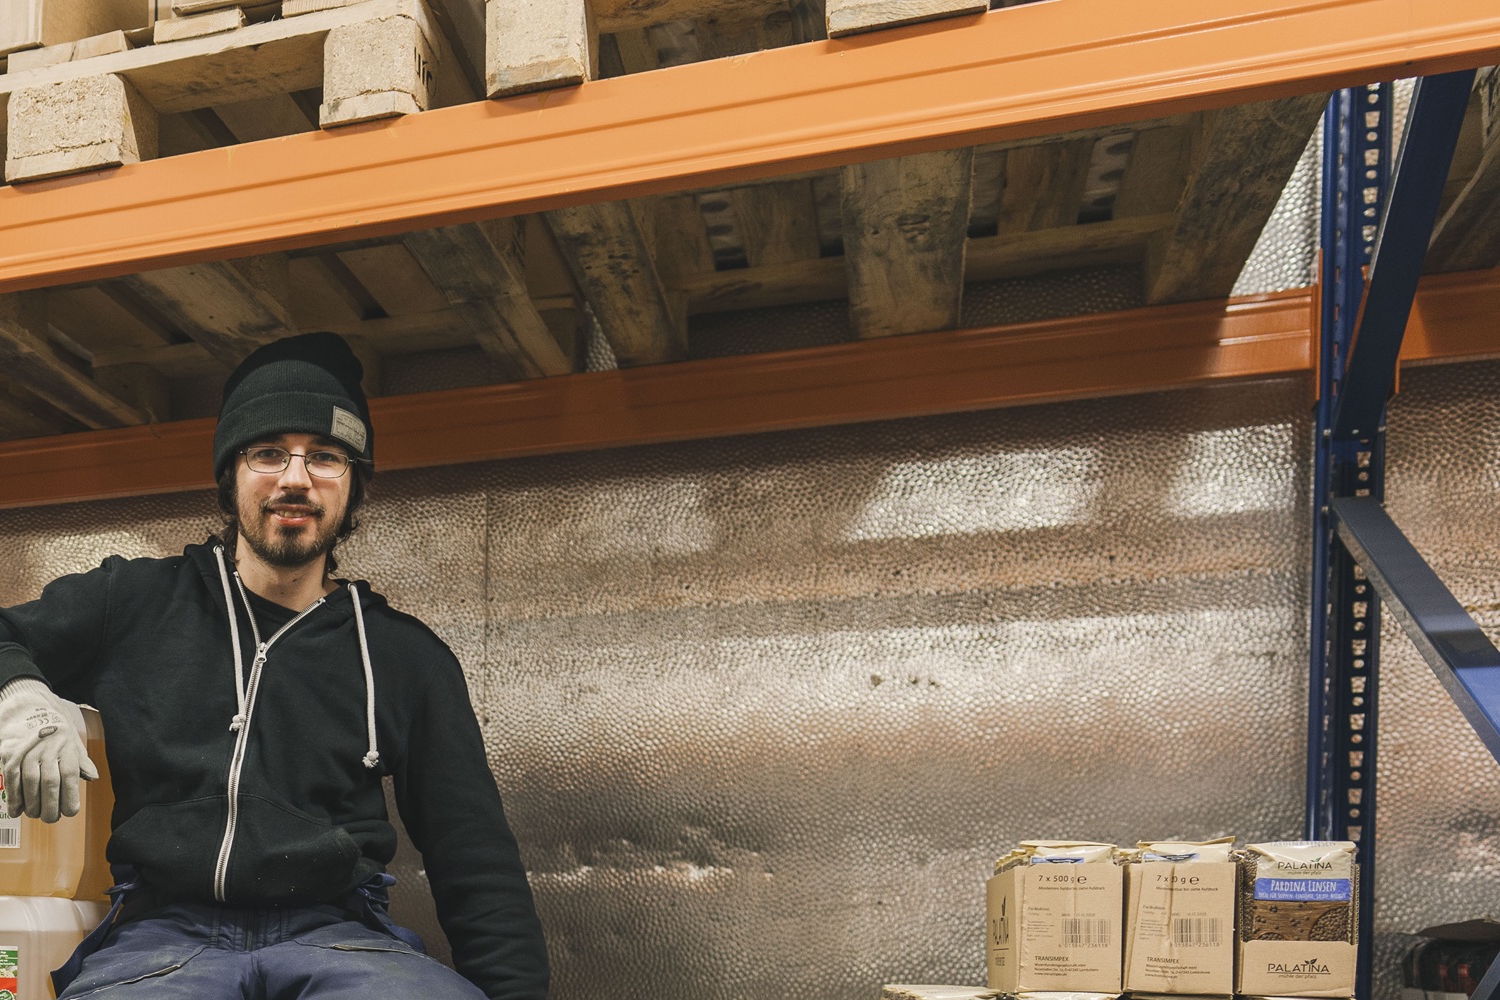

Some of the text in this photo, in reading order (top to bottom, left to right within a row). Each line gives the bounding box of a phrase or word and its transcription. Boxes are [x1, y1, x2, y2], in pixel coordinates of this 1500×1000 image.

[1277, 861, 1333, 870] PALATINA
[1270, 880, 1337, 892] PARDINA LINSEN
[1146, 956, 1180, 964] TRANSIMPEX
[1267, 963, 1330, 973] PALATINA
